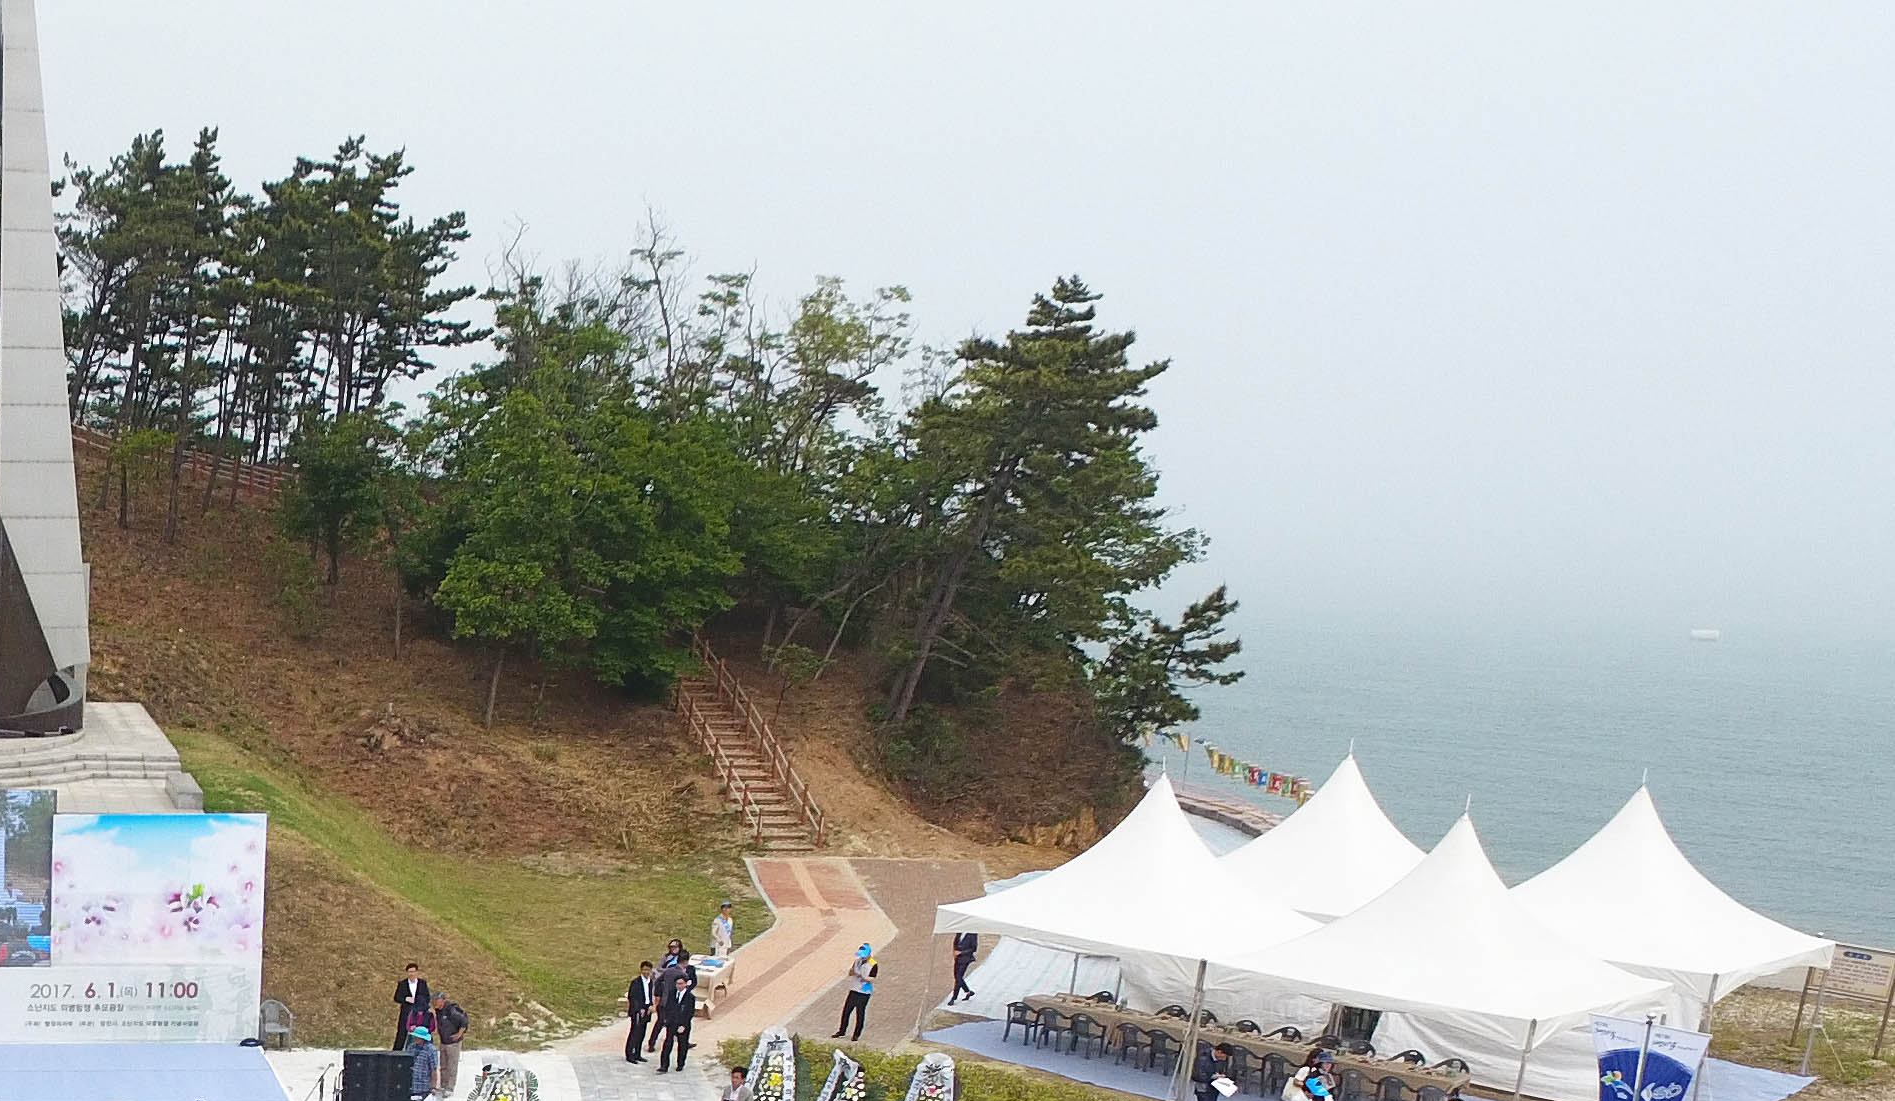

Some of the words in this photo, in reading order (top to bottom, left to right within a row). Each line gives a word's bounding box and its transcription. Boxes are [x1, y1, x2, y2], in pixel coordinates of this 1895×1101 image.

[30, 984, 75, 999] 2017.
[147, 982, 199, 999] 11:00
[27, 1003, 57, 1013] 소난지도
